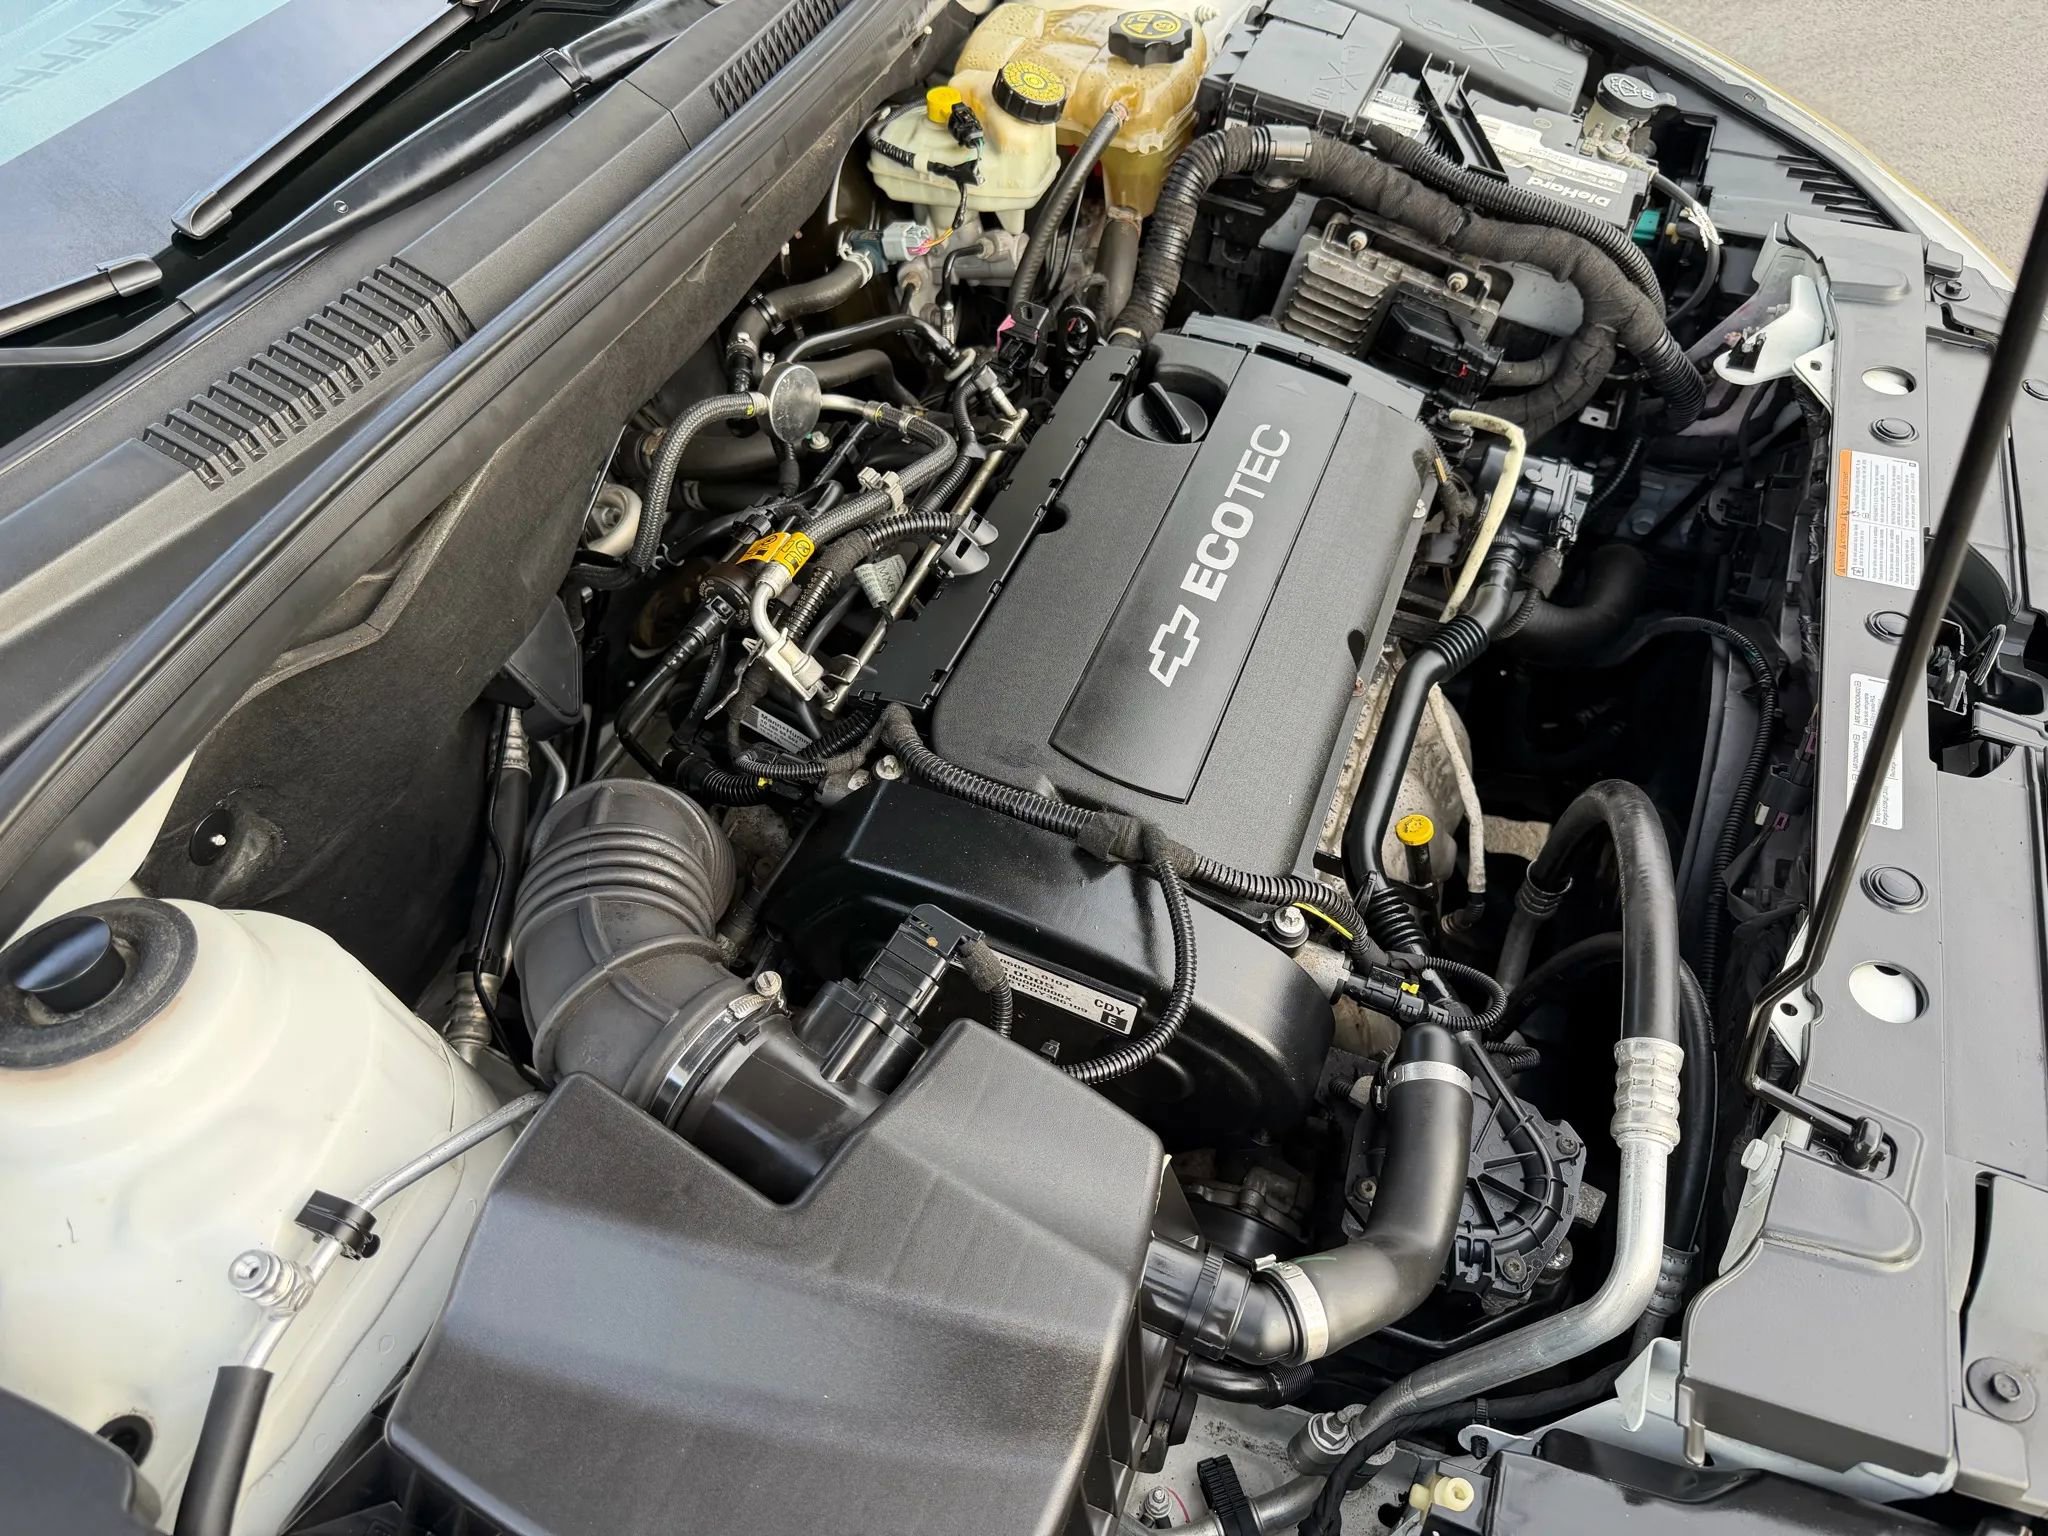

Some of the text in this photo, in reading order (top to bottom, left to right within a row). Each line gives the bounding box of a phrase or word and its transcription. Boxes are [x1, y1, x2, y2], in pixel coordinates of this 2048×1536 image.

[1526, 176, 1612, 208] DieHard
[1180, 424, 1290, 602] ECOTEC
[1094, 998, 1126, 1016] CDY
[1107, 1015, 1118, 1026] E
